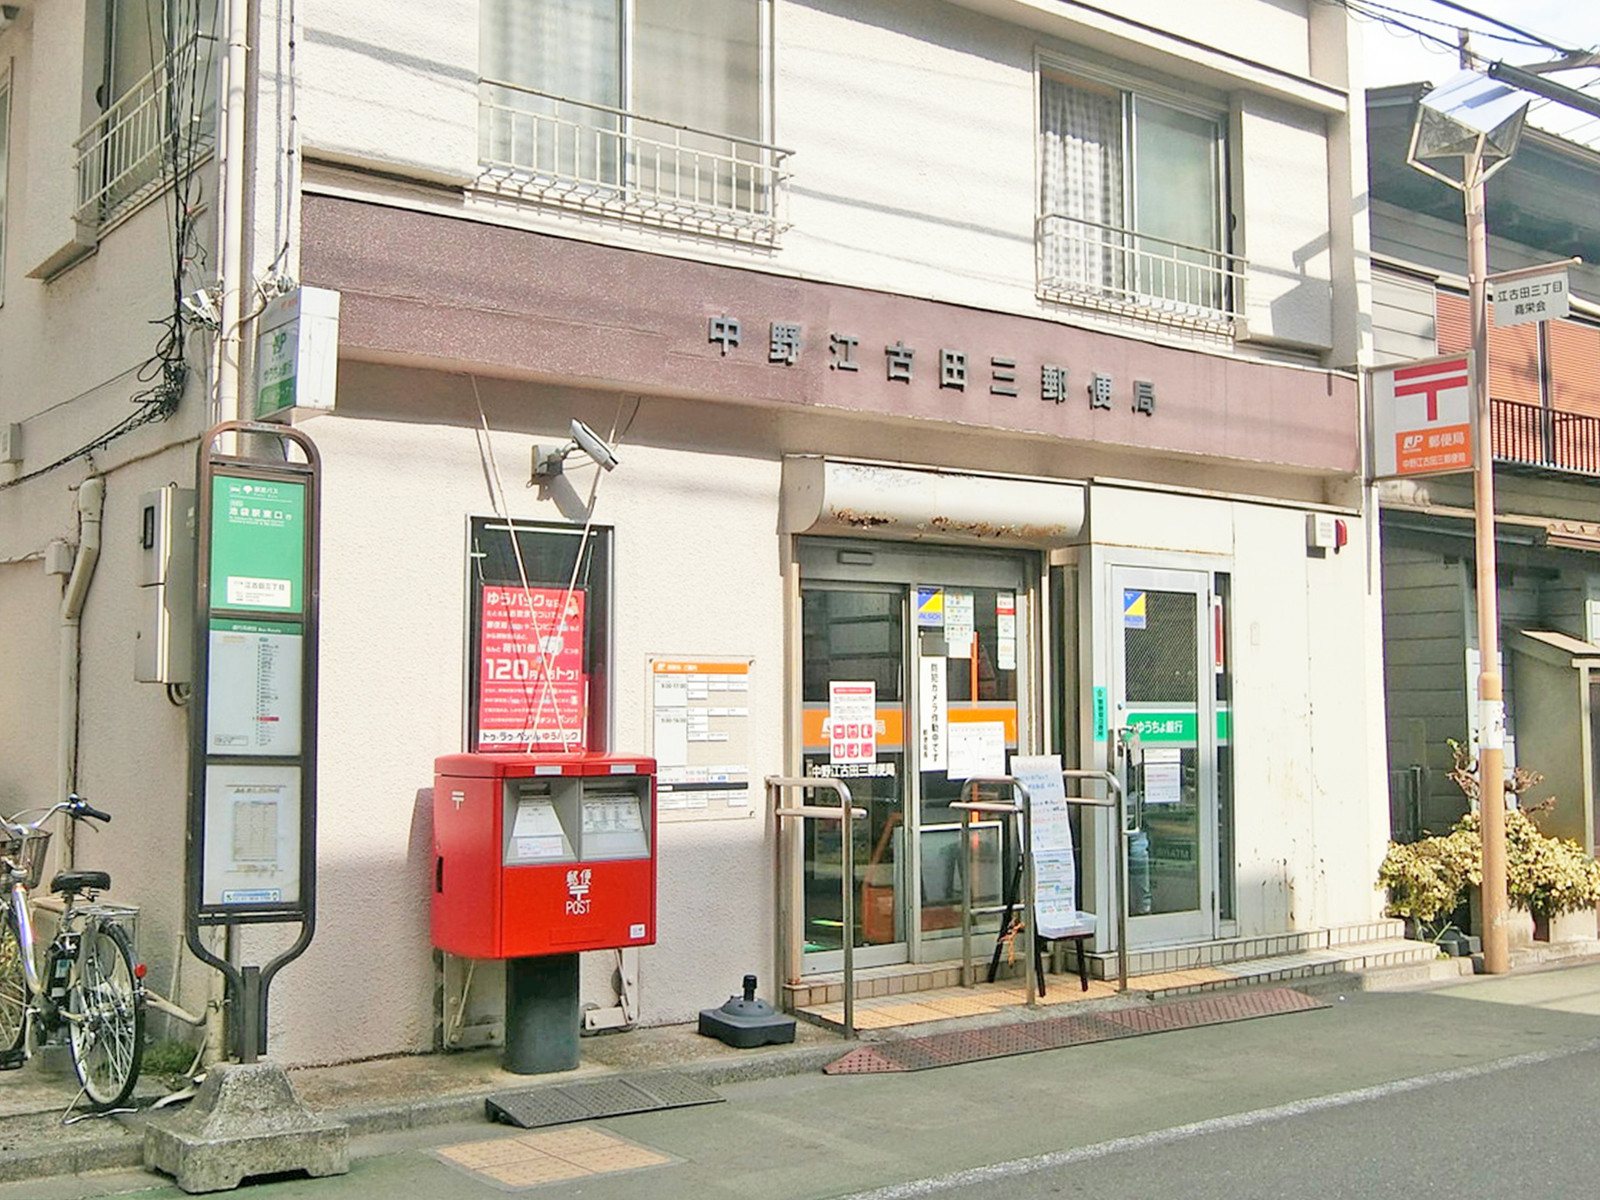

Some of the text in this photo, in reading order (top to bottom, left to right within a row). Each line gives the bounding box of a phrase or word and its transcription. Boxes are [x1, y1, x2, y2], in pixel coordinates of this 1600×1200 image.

[1498, 281, 1562, 302] 江古田三丁目
[708, 314, 1156, 416] 中野江古田三郵便局
[1136, 720, 1183, 734] ゆうちょ銀行
[812, 762, 896, 778] 中野江古田三郵便局
[566, 869, 592, 887] 郵便
[566, 900, 592, 916] POST
